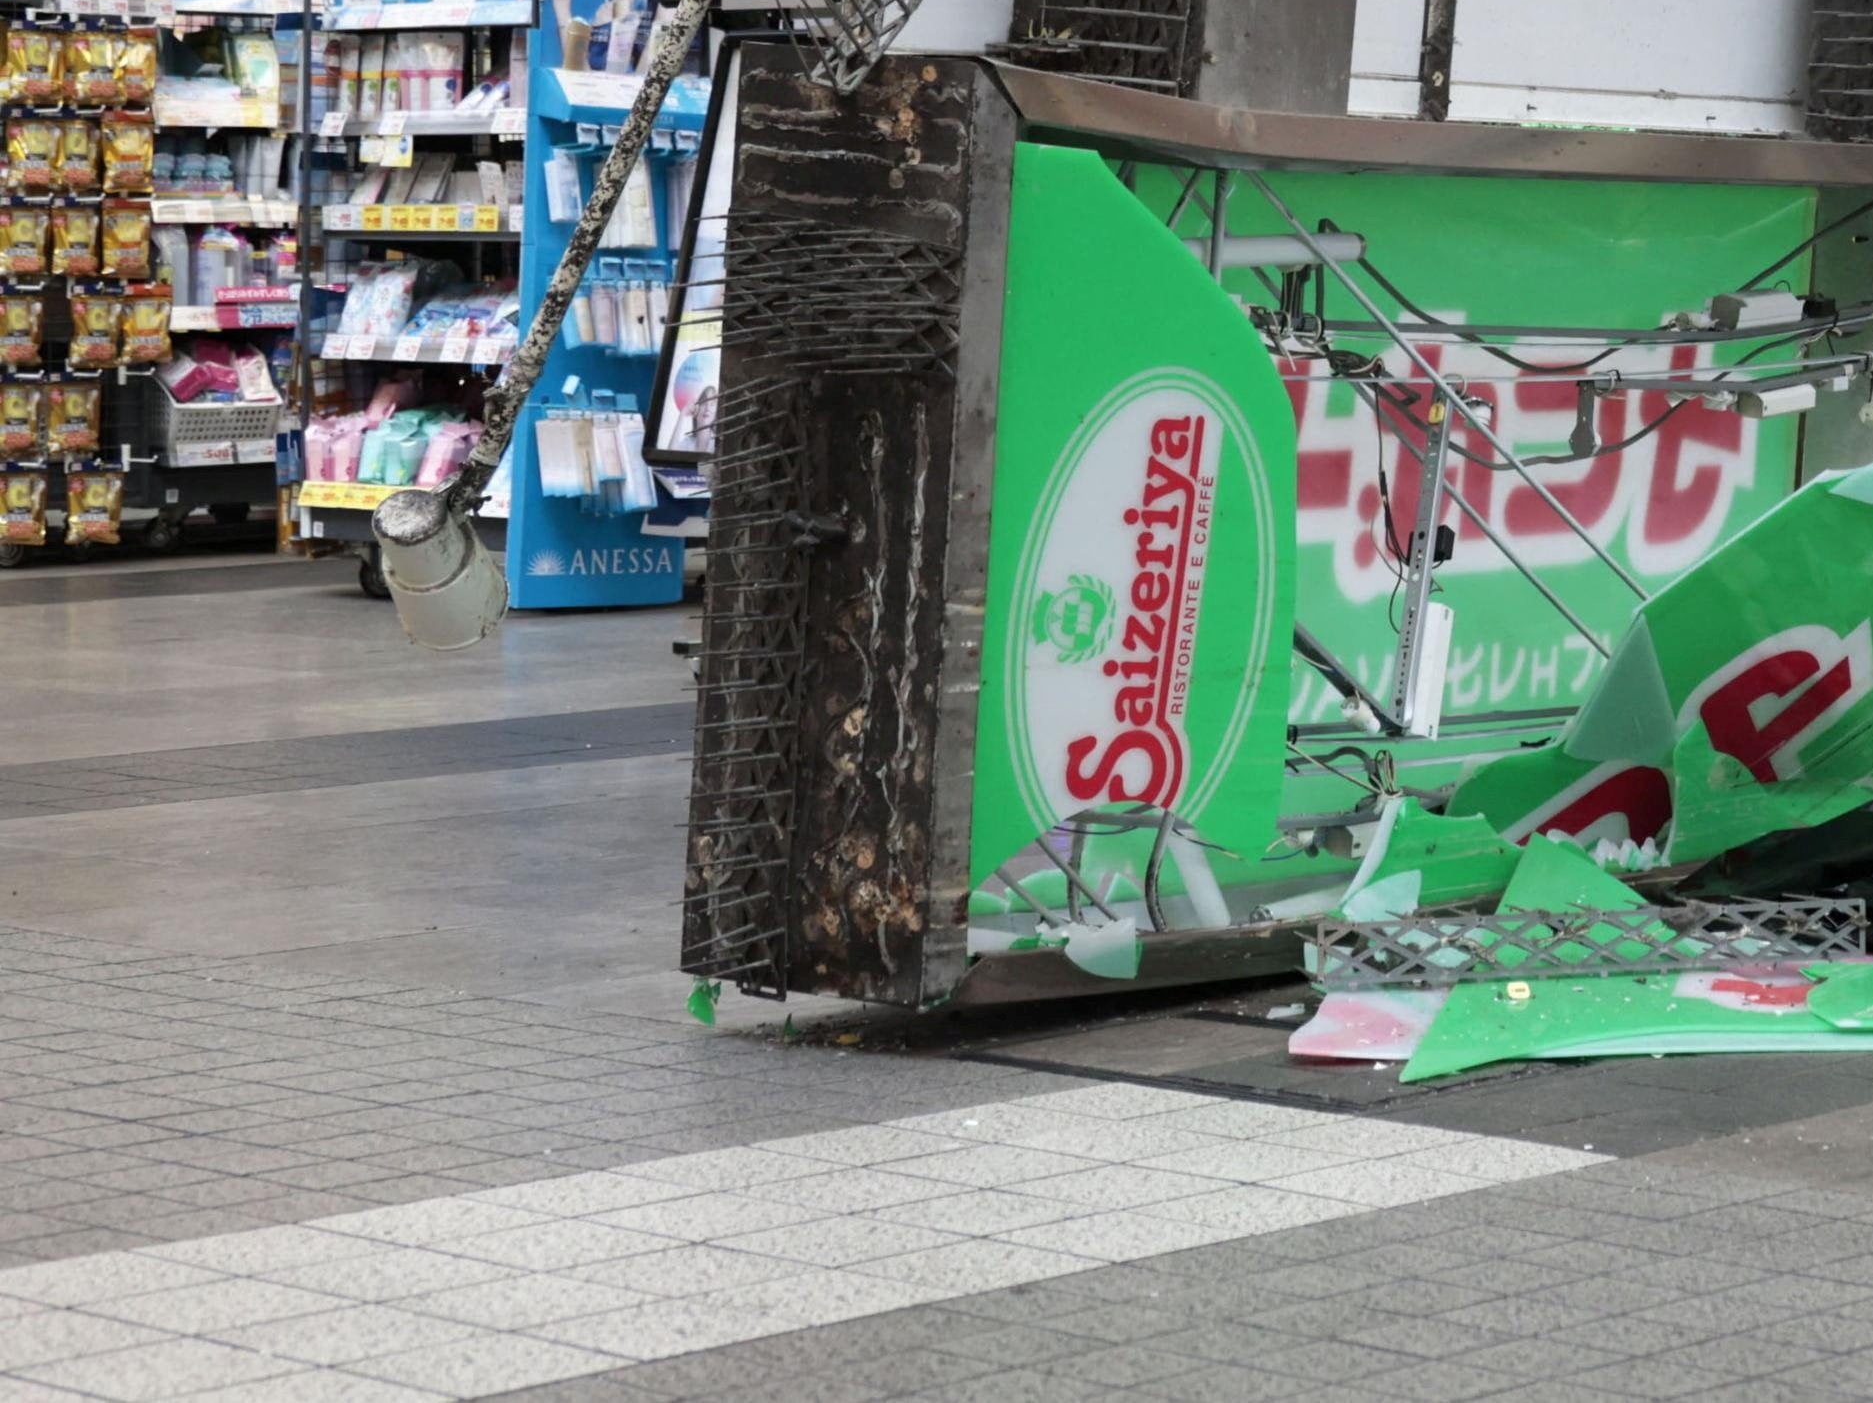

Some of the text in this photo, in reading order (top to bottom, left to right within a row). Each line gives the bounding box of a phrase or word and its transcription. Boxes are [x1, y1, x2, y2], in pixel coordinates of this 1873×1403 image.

[569, 547, 673, 576] ANESSA
[1066, 414, 1206, 813] Saizeriya
[1170, 577, 1202, 716] RISTORANTE
[1190, 554, 1204, 568] E
